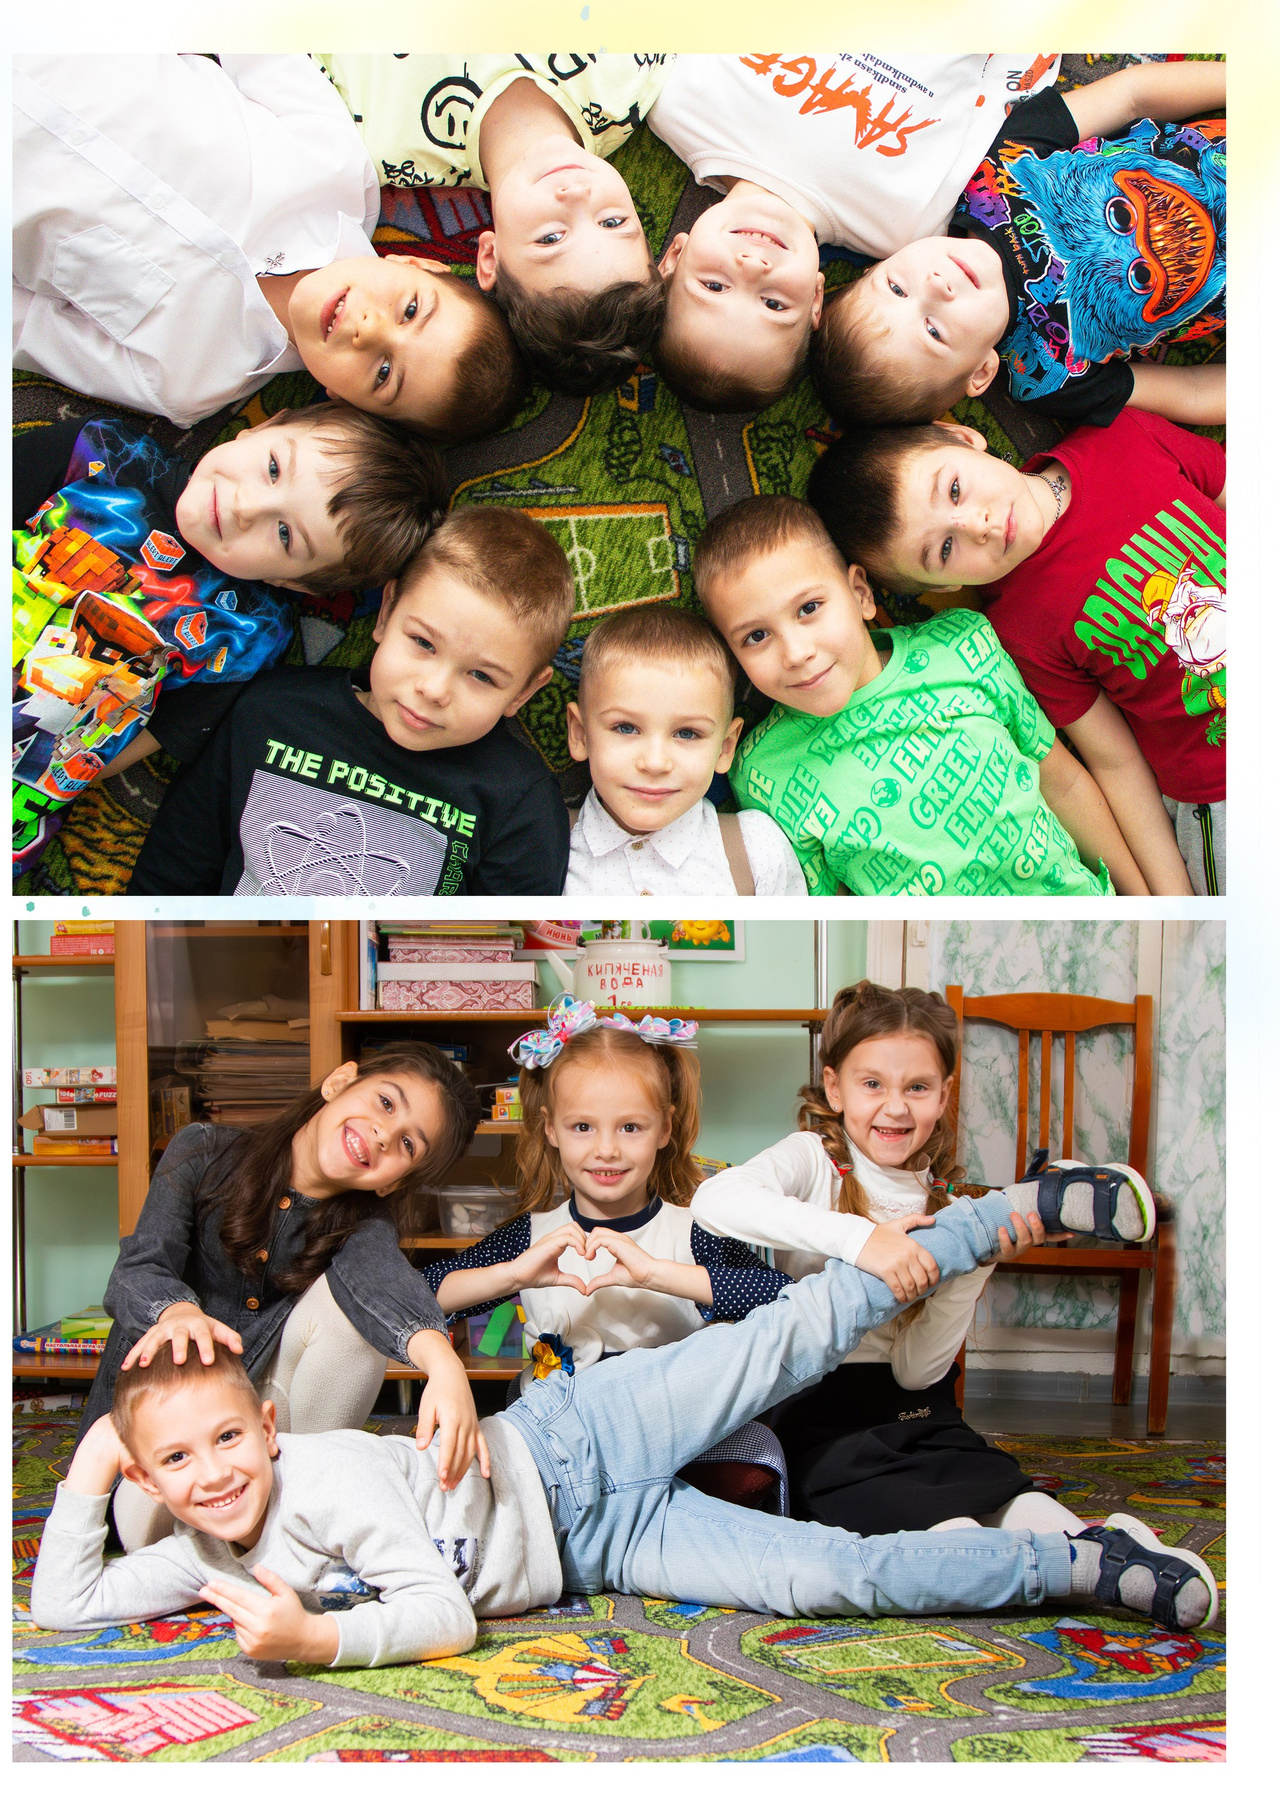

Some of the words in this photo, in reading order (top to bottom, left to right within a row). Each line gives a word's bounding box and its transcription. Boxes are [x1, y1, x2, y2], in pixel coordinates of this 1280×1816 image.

[264, 738, 324, 779] THE
[326, 759, 477, 838] POSITIVE
[909, 730, 982, 829] GREEN
[943, 737, 1014, 850] FUTURE
[546, 927, 572, 942] ИЮНЬ
[587, 962, 664, 977] КИПЯЧЕНАЯ
[600, 976, 644, 990] ВОДА
